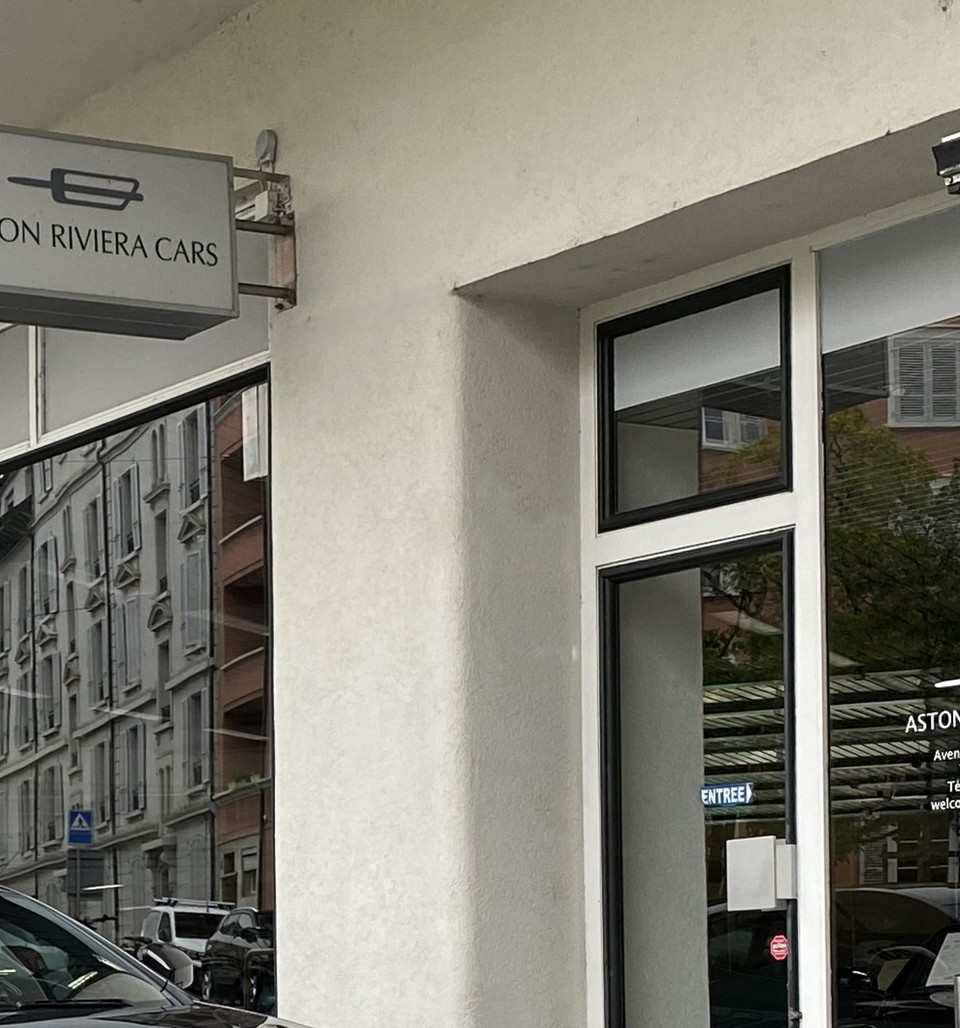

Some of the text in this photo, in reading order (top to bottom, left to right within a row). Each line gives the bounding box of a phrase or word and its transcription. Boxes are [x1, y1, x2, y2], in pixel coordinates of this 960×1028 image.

[51, 224, 148, 259] RIVIERA
[155, 236, 219, 267] CARS
[700, 786, 745, 805] ENTREE
